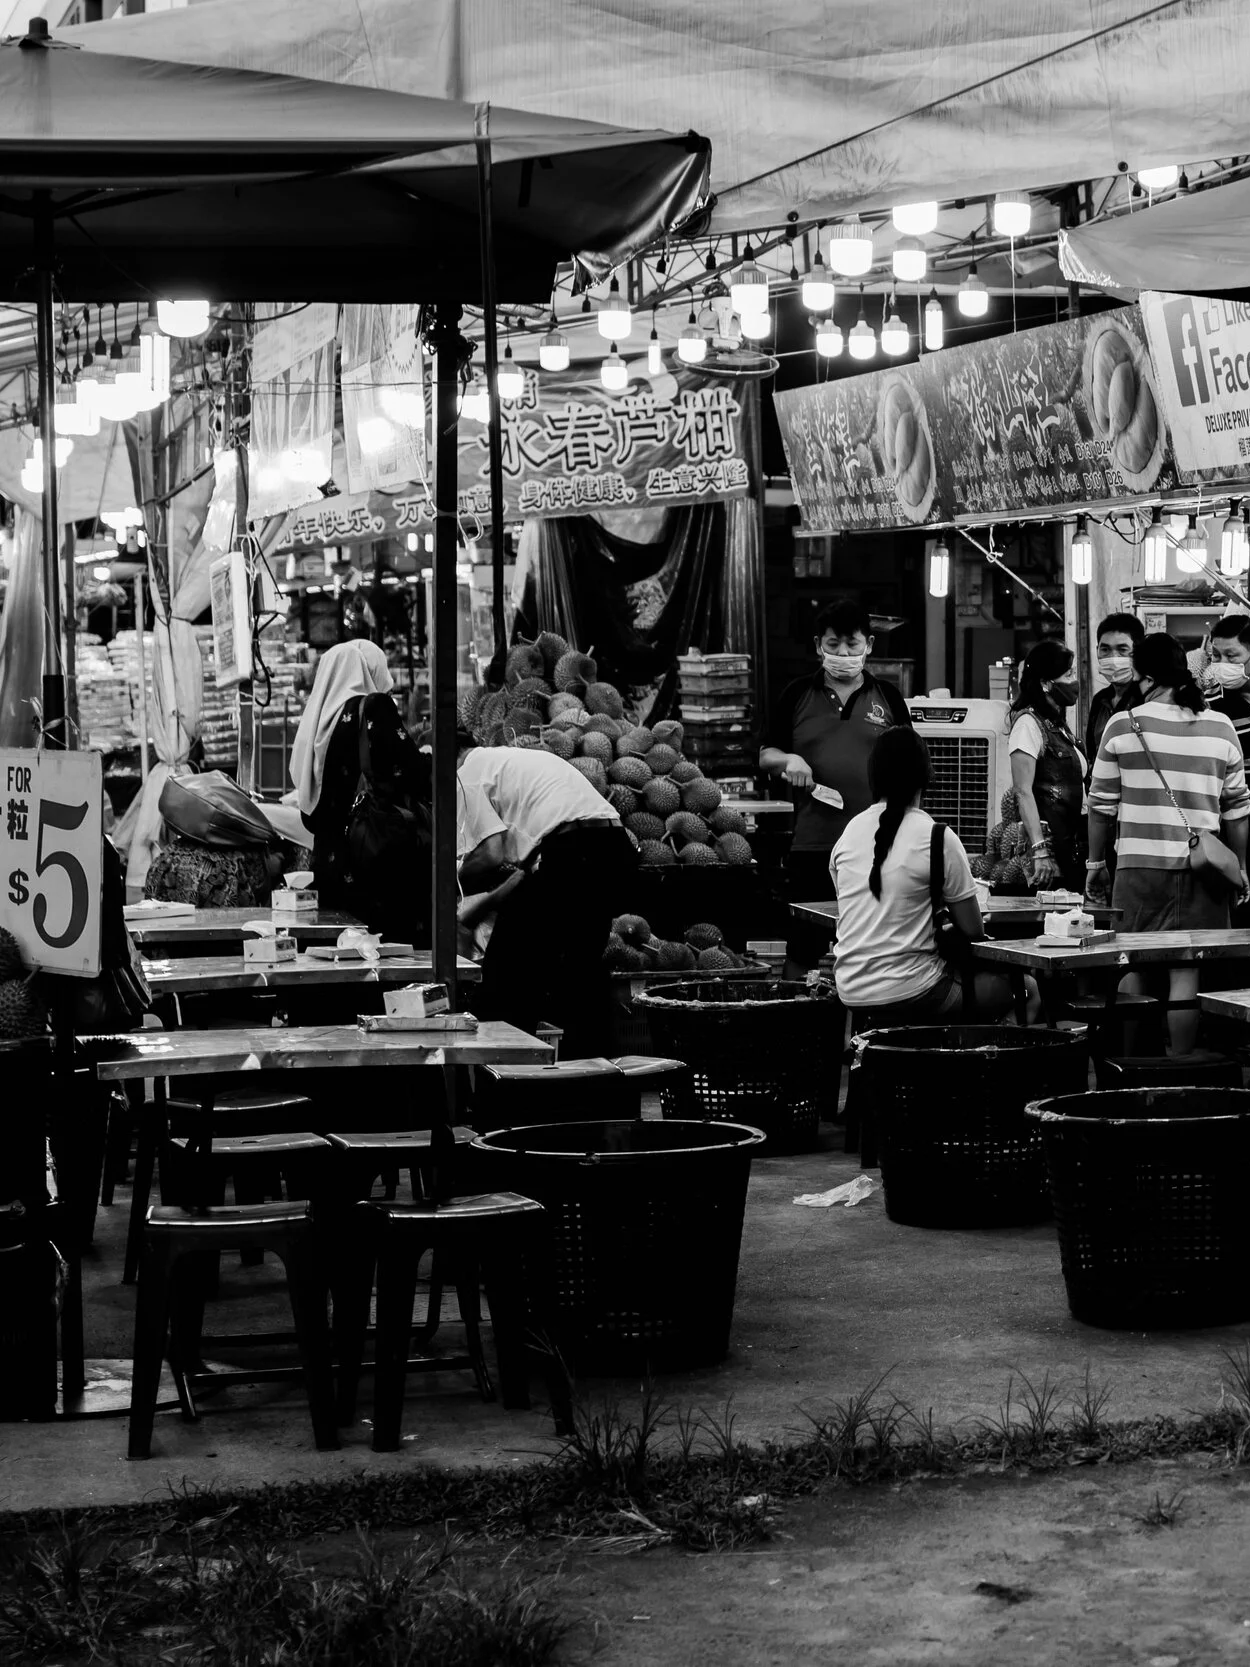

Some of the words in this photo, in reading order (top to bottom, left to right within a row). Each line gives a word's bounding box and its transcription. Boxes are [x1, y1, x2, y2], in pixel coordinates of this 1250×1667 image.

[479, 387, 741, 476] 永春芦柑
[1205, 412, 1232, 433] DELUXE
[1106, 471, 1124, 487] D26
[282, 507, 386, 544] 年快乐，
[647, 457, 749, 497] 生意兴隆
[7, 766, 31, 793] FOR
[0, 798, 29, 840] 粒
